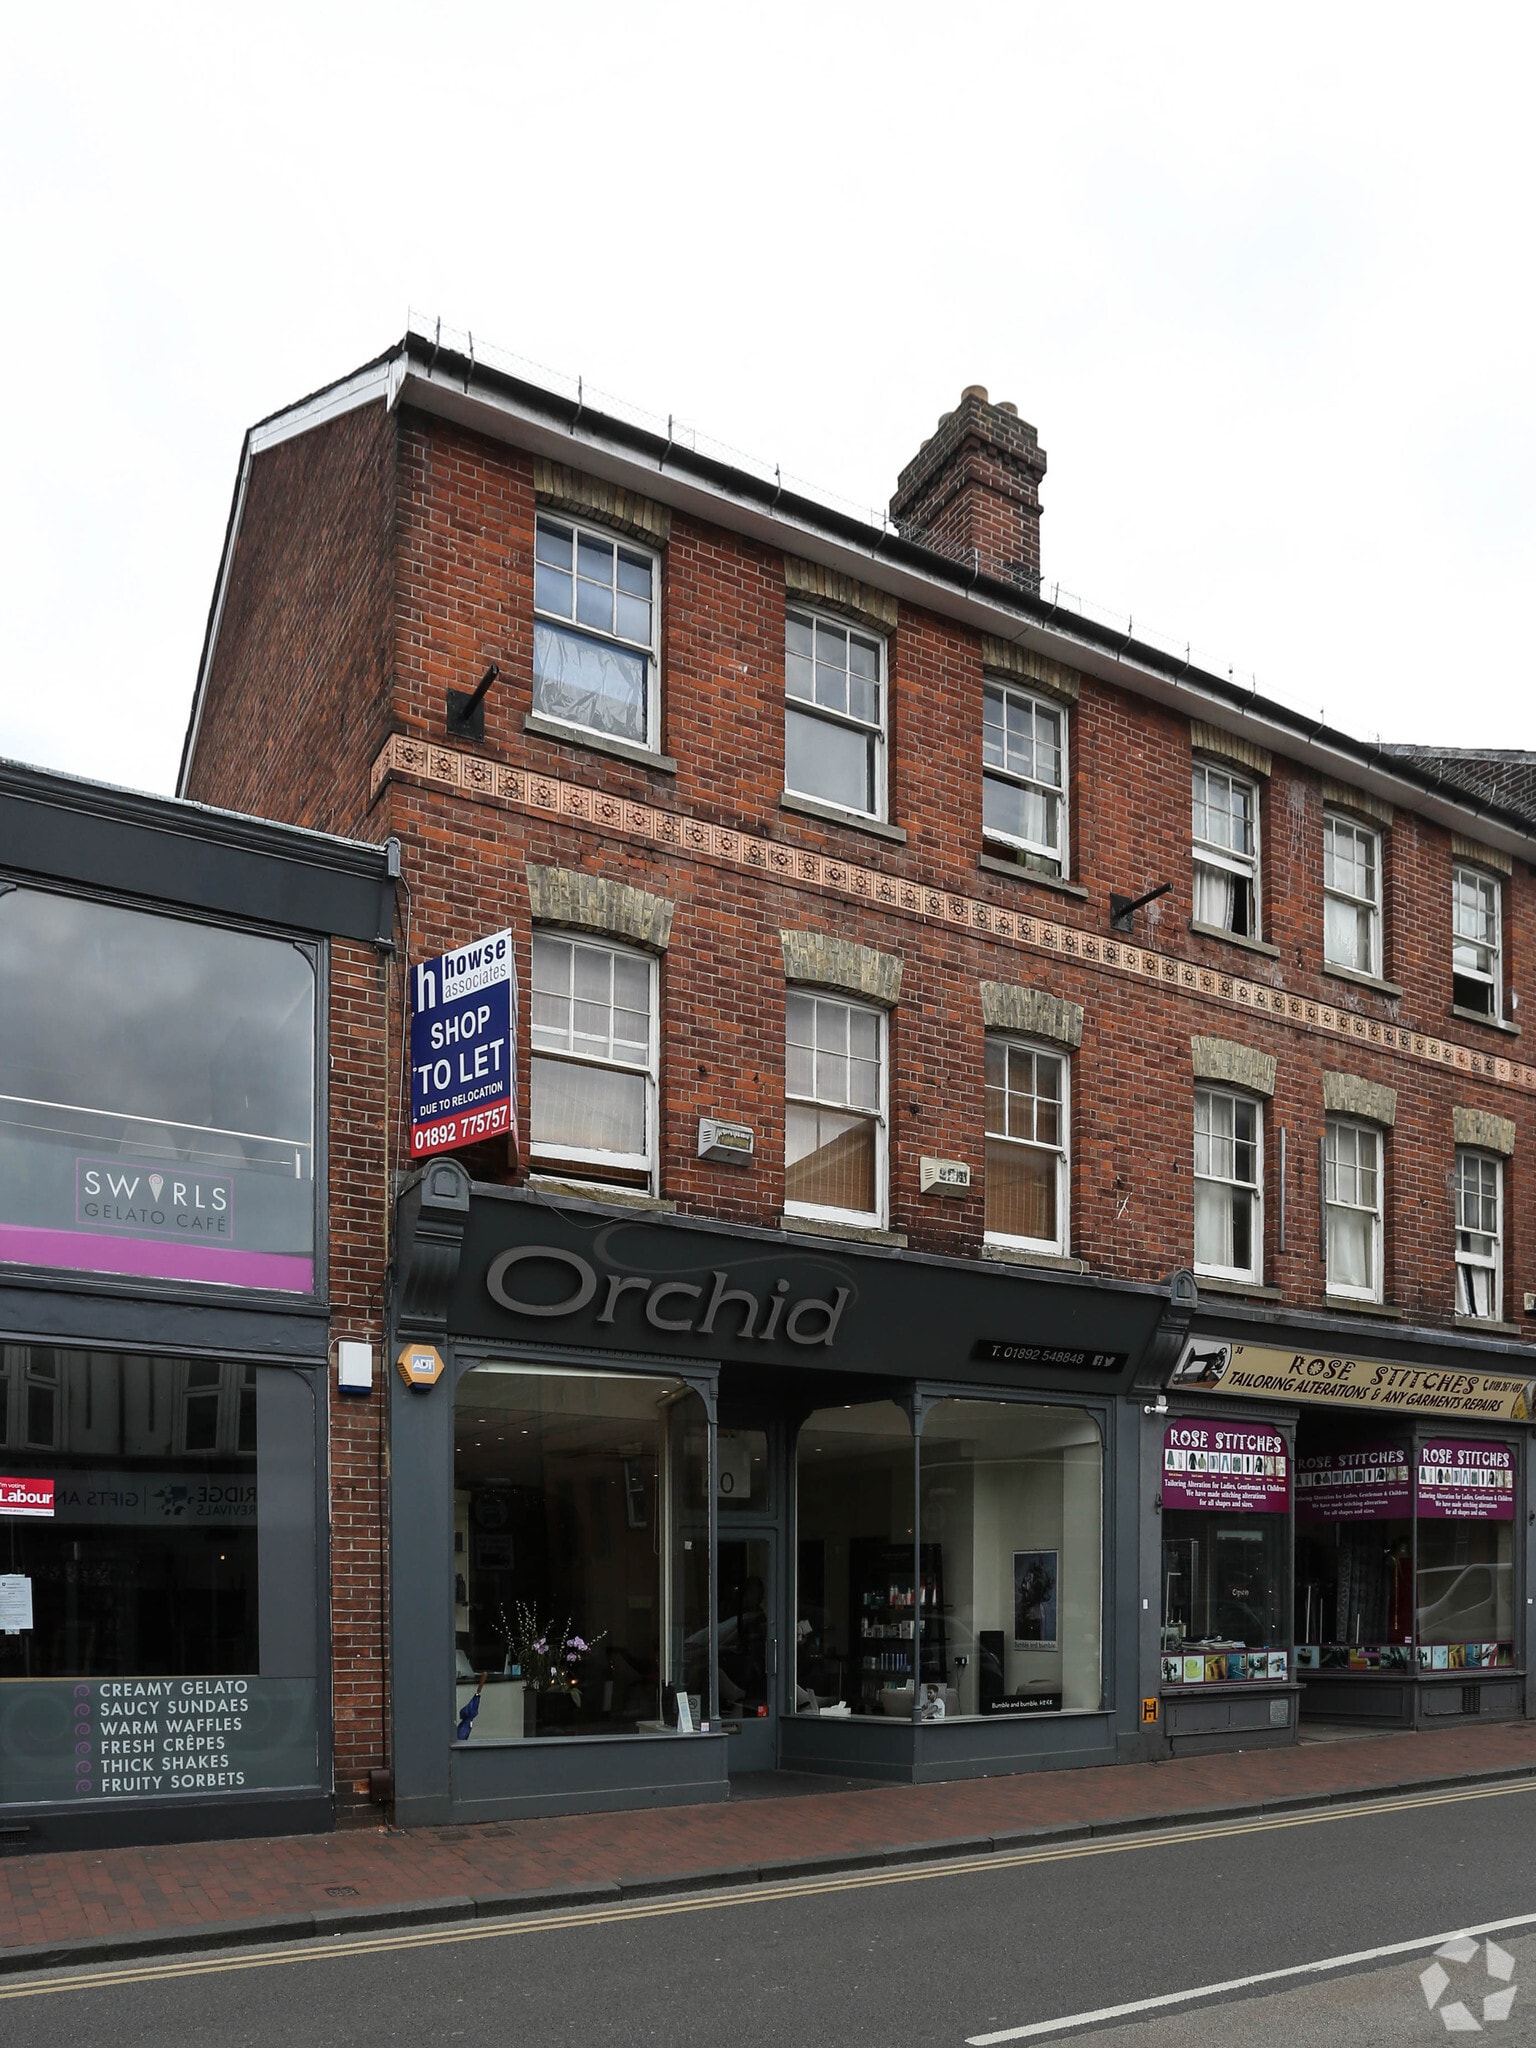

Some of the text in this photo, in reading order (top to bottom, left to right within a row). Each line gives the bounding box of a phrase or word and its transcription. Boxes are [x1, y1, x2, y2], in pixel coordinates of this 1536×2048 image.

[445, 938, 506, 980] howse
[445, 962, 507, 998] associates
[430, 1005, 491, 1050] SHOP
[418, 1038, 504, 1095] TO LET
[420, 1080, 503, 1116] DUE TO RELOCATION
[414, 1105, 508, 1150] 01892 775757
[84, 1203, 226, 1232] GELATO CAFÉ
[486, 1245, 850, 1346] Orchid
[1004, 1346, 1040, 1360] 01892
[1042, 1350, 1085, 1364] 548848
[1235, 1346, 1244, 1354] 38
[413, 1359, 435, 1370] ADT
[1288, 1354, 1479, 1395] ROSE STITCHES
[1228, 1371, 1504, 1412] TAILORING ALTERATIONS & ANY GARMENTS REPAIRS
[1170, 1429, 1282, 1453] ROSE STITCHES
[1298, 1450, 1405, 1469] ROSE STITCHES
[1422, 1448, 1510, 1467] ROSE STITCHES
[1165, 1479, 1186, 1489] Tailoring
[1187, 1480, 1211, 1489] Alteration
[0, 1489, 53, 1504] Labour
[1186, 1489, 1194, 1497] We
[1221, 1491, 1241, 1500] stitching
[1215, 1500, 1231, 1508] shapes
[1232, 1588, 1249, 1597] Open
[100, 1680, 248, 1697] CREAMY GELATO
[100, 1698, 248, 1716] SAUCY SUNDAES
[100, 1717, 242, 1736] WARM WAFFLES
[101, 1734, 225, 1754] FRESH CRÊPES
[101, 1754, 229, 1773] THICK SHAKES
[102, 1772, 245, 1792] FRUITY SORBETS
